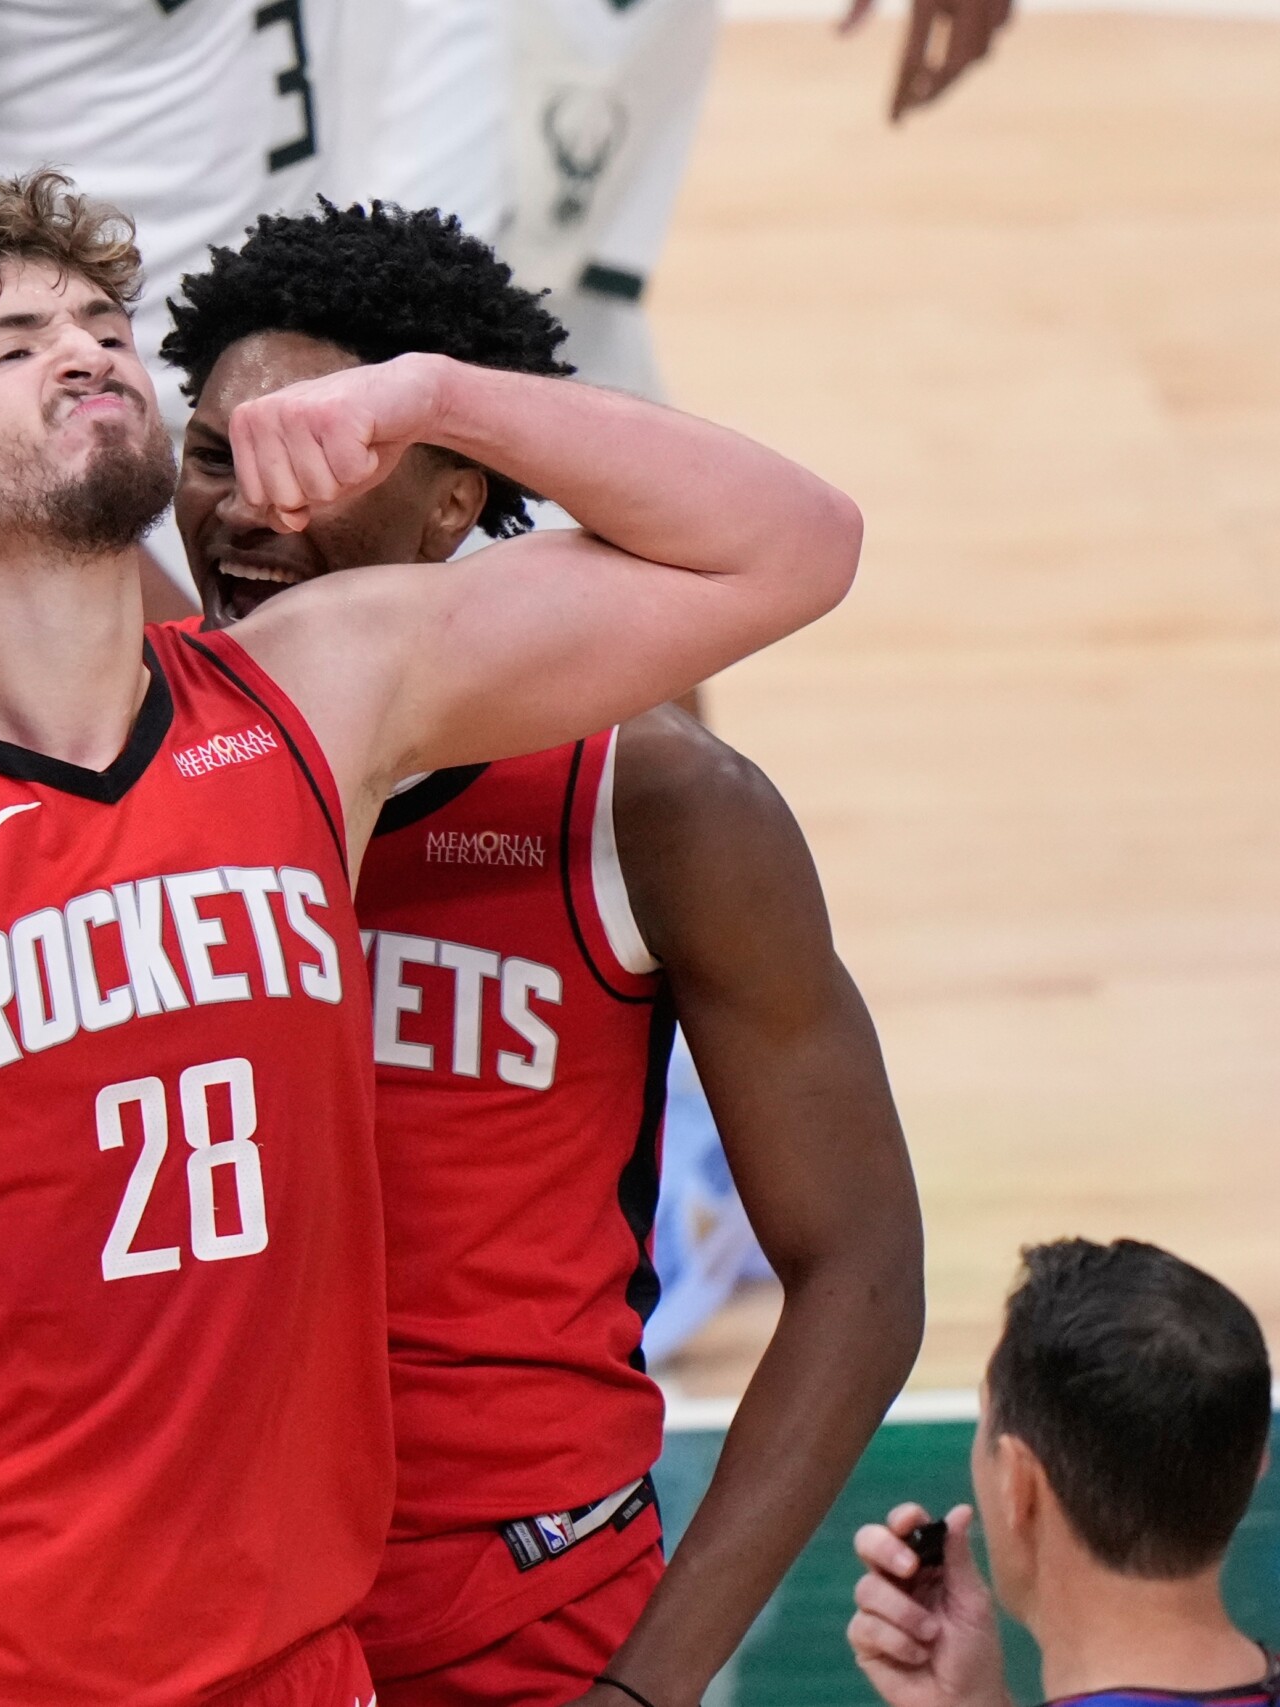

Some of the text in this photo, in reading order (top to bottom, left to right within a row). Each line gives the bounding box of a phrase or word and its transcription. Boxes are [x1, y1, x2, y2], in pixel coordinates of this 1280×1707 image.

[172, 725, 272, 766] MEMORIAL
[176, 736, 278, 777] HERMANN
[426, 831, 545, 852] MEMORIAL
[426, 846, 544, 867] HERMANN
[361, 929, 563, 1091] ETS
[95, 1057, 269, 1281] 28
